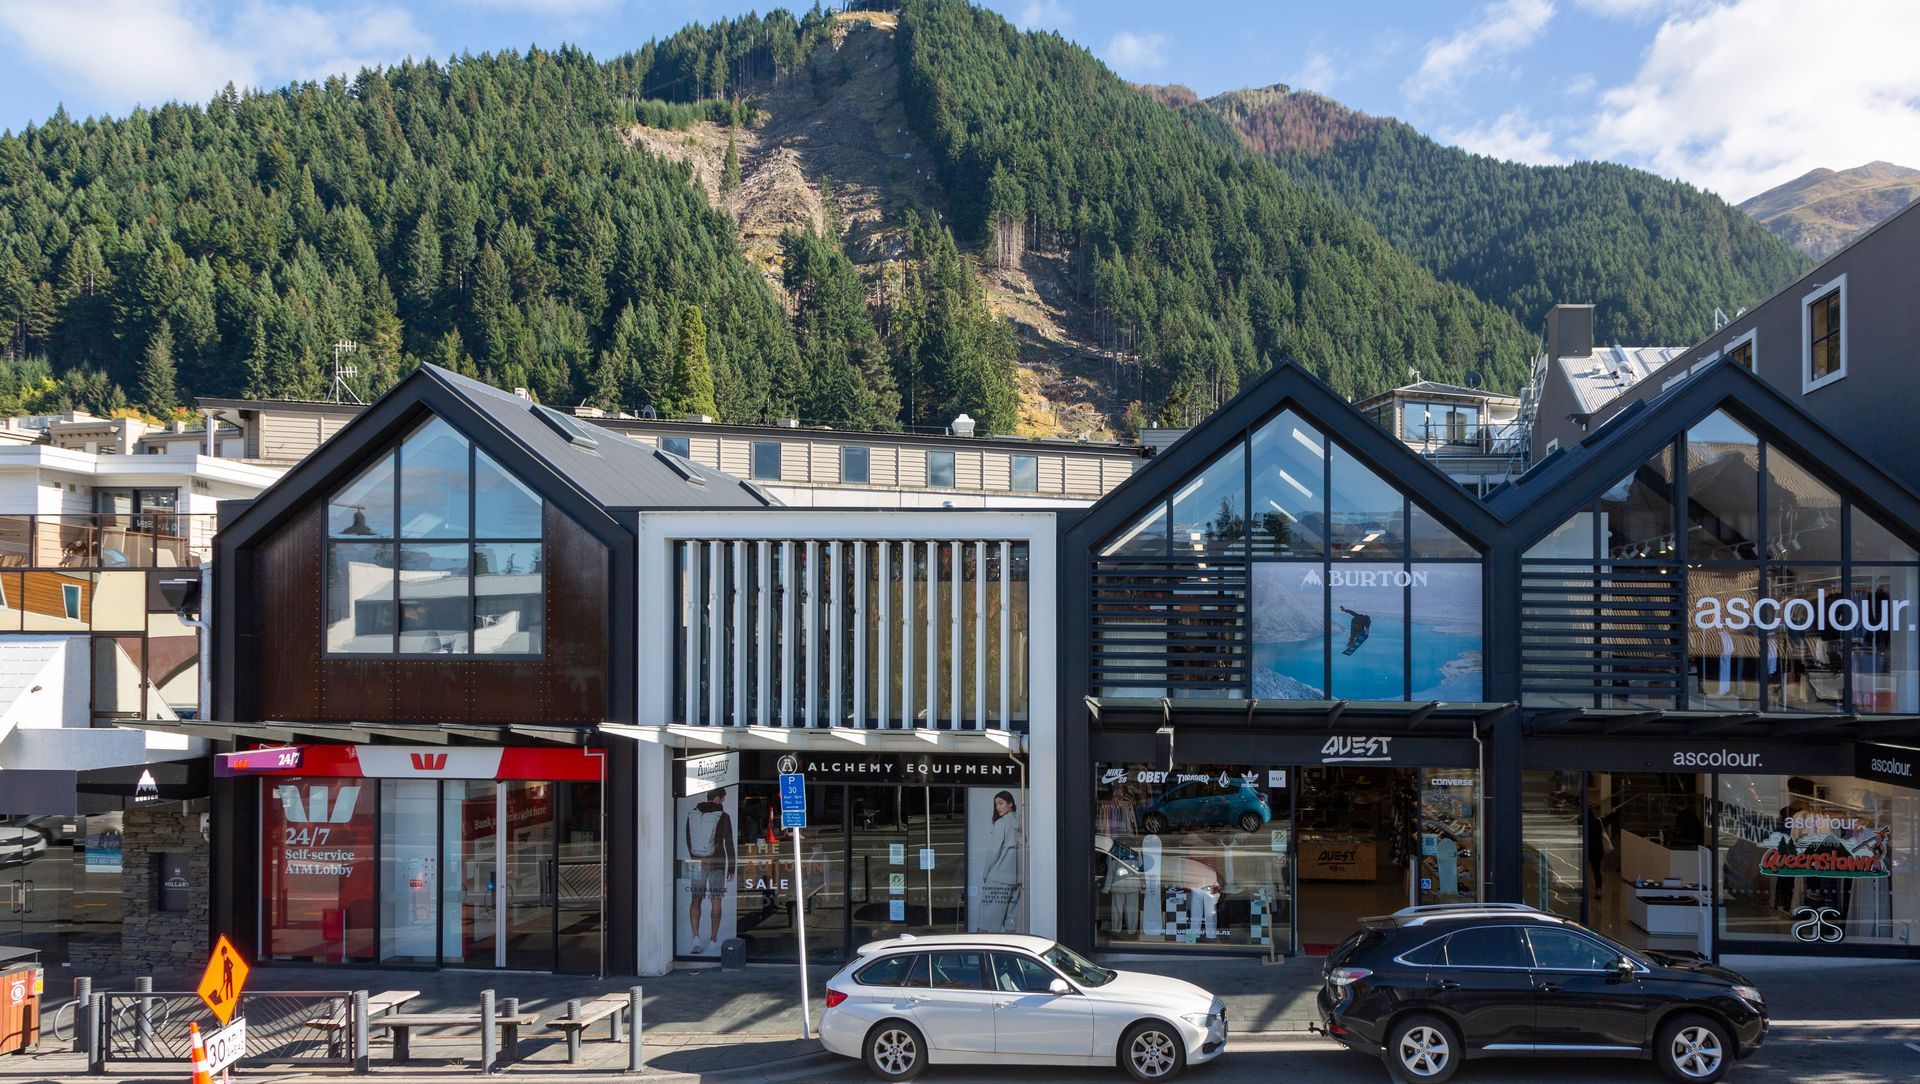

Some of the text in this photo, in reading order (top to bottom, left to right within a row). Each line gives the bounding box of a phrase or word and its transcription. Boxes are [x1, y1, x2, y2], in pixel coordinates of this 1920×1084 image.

[1328, 570, 1428, 587] BURTON
[1694, 588, 1916, 632] ascolour.
[1321, 736, 1392, 756] QUEST
[278, 752, 300, 766] 24/7
[1673, 749, 1763, 767] ascolour.
[697, 759, 729, 777] Alchemy
[808, 762, 1015, 775] ALCHEMY EQUIPMENT
[1106, 768, 1124, 777] NIKE
[1871, 757, 1912, 777] ascolour.
[788, 776, 796, 785] P
[1137, 770, 1169, 784] OBEY
[1176, 773, 1210, 785] THRASHER
[1431, 778, 1473, 786] CONVERSE
[788, 786, 797, 794] 30
[1784, 813, 1861, 830] ascolour.
[285, 827, 331, 848] 24/7
[285, 849, 355, 861] Self-service
[745, 843, 780, 854] THE
[1318, 851, 1356, 862] QUEST
[1761, 849, 1881, 872] Queenstown
[284, 863, 353, 877] ATM Lobby
[745, 878, 789, 889] SALE
[209, 1039, 226, 1068] 30
